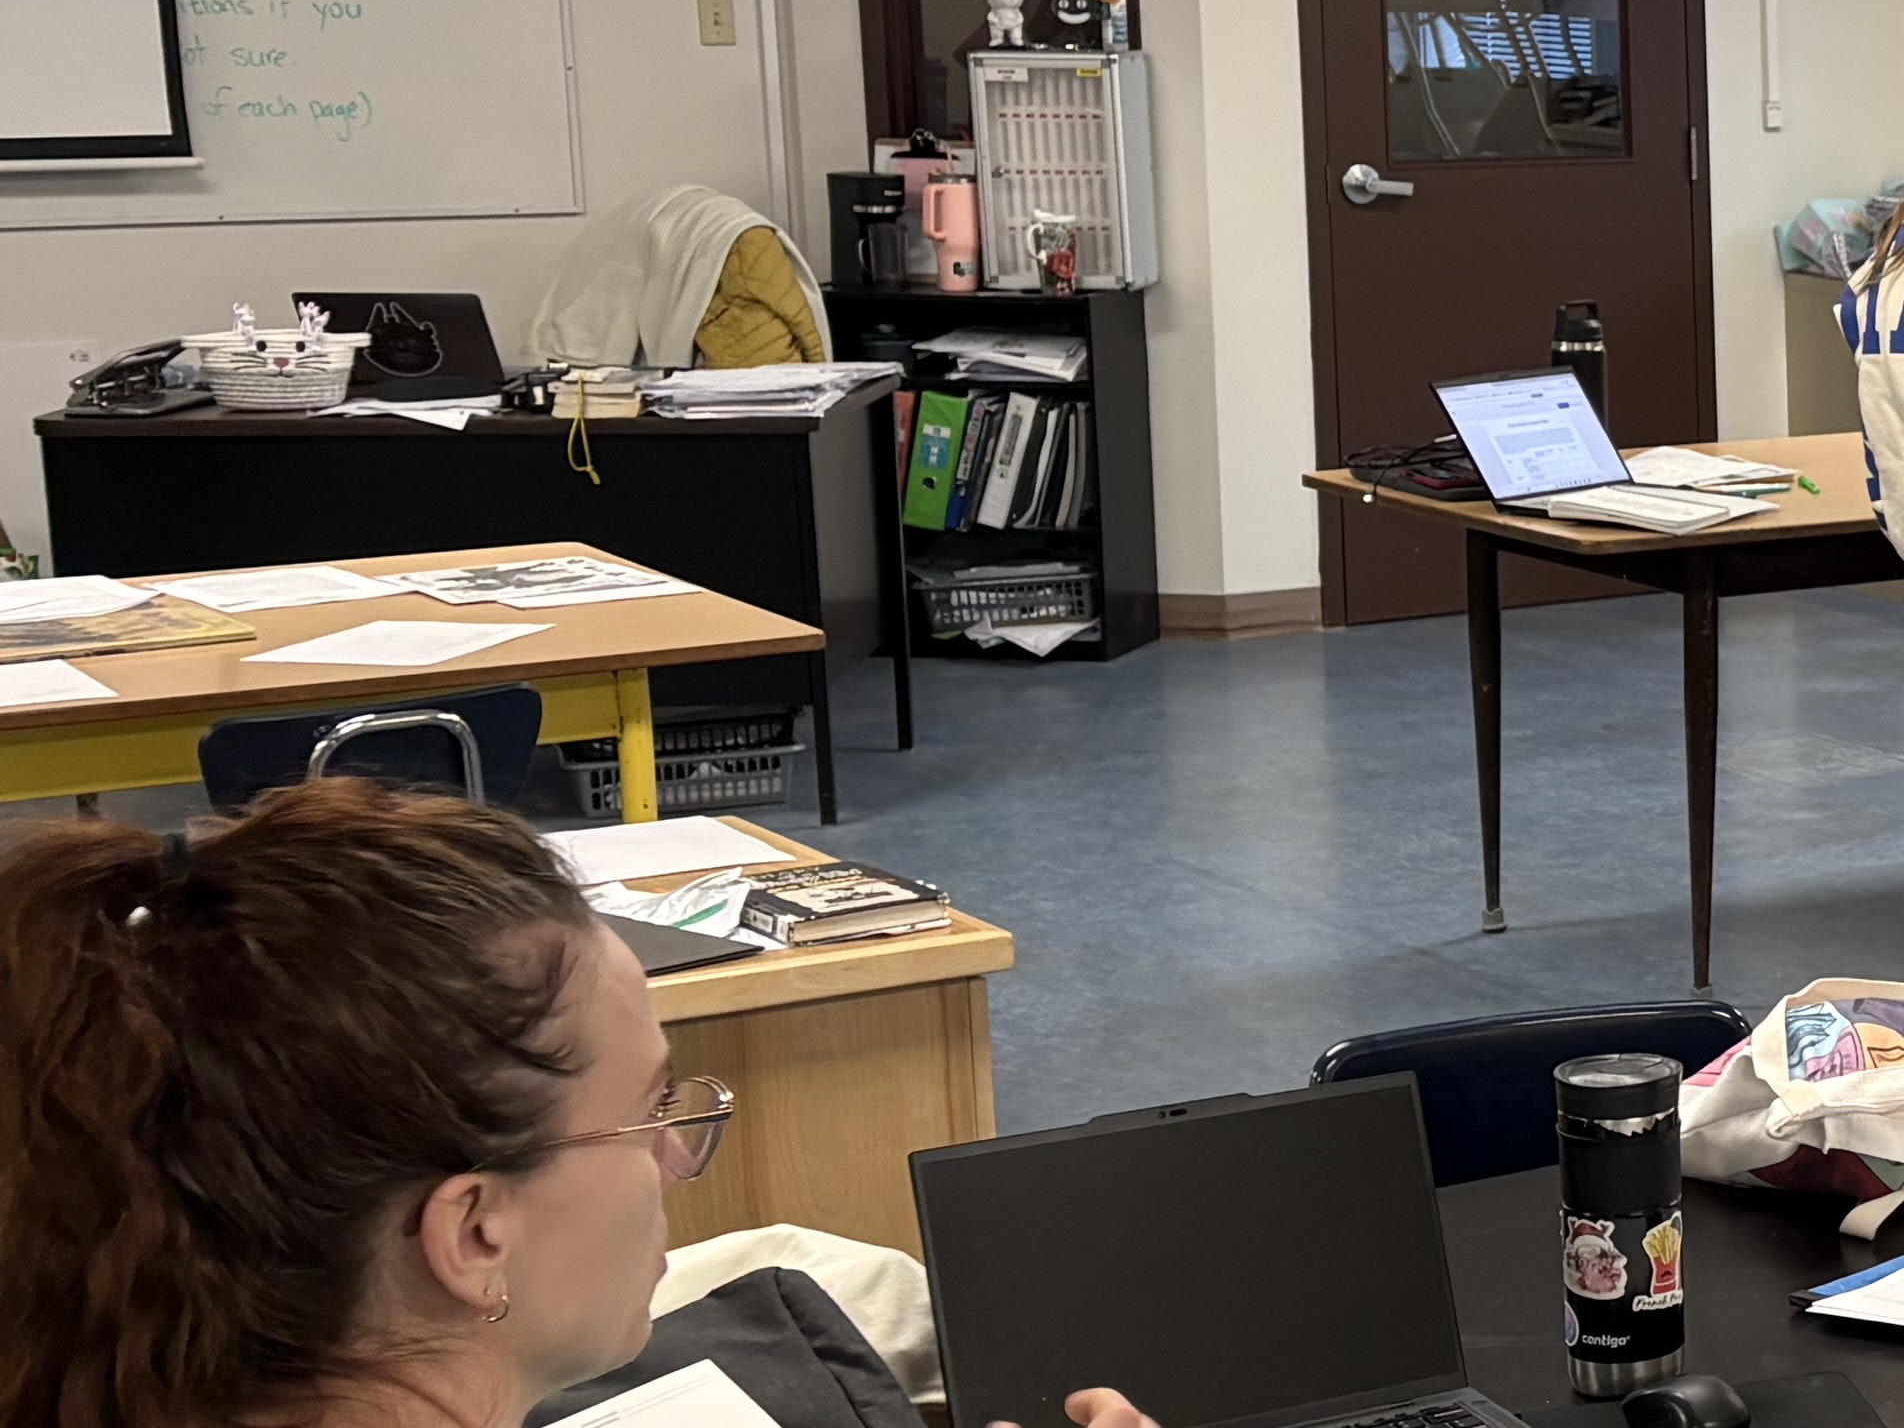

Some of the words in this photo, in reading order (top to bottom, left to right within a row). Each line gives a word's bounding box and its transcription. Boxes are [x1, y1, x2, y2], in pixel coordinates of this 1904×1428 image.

[312, 1, 362, 32] you
[230, 47, 288, 68] sure
[238, 95, 297, 119] each
[308, 90, 373, 142] page)
[1581, 1333, 1627, 1349] contigo
